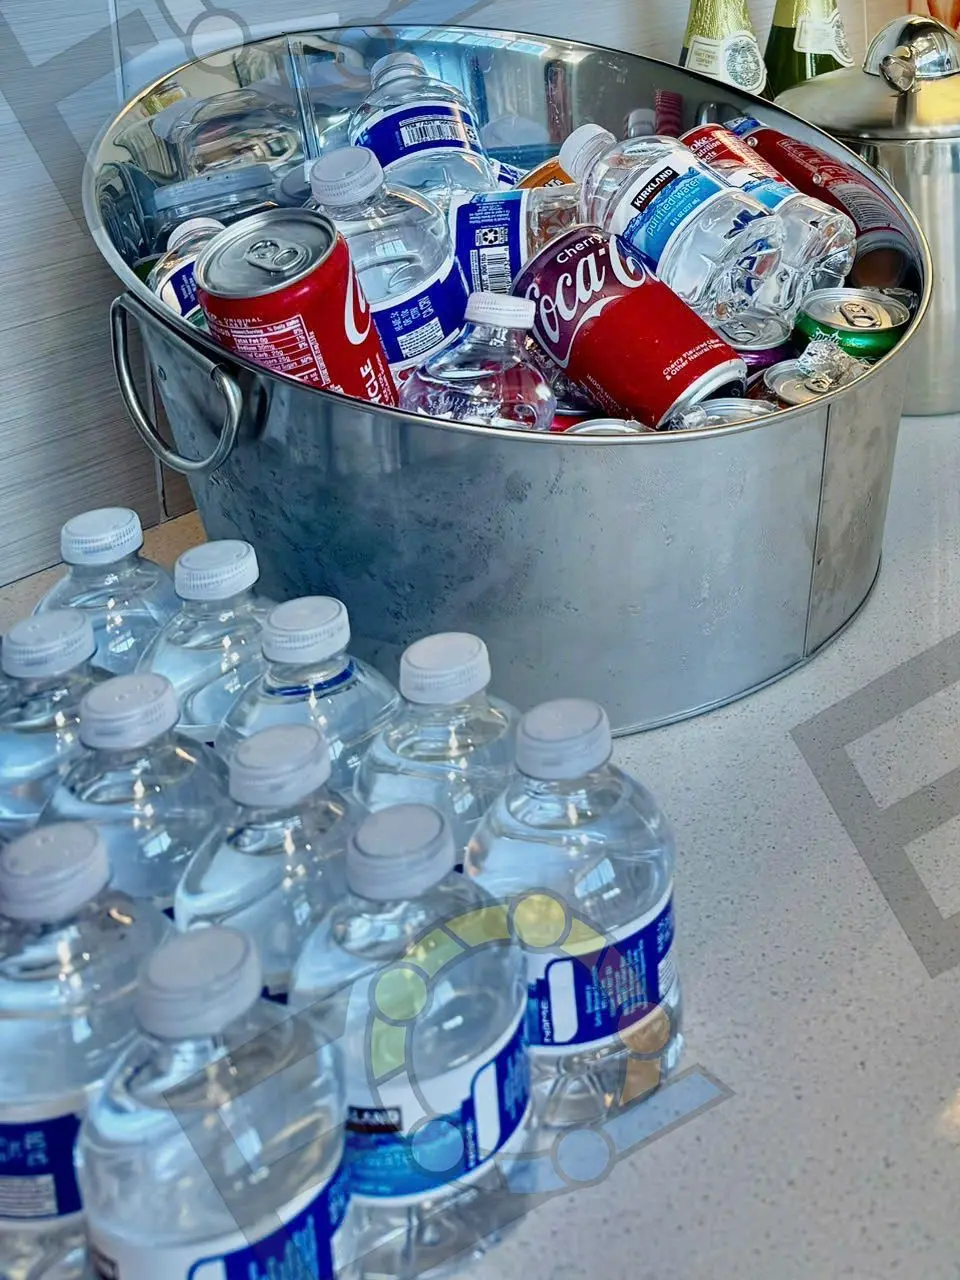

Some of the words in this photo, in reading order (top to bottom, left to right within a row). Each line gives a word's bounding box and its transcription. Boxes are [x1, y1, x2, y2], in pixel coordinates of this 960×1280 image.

[697, 140, 721, 157] utrition
[633, 169, 673, 207] KIRKLAND
[646, 194, 678, 238] purified
[677, 177, 701, 200] water
[556, 233, 603, 265] Cherry
[671, 359, 689, 375] Other
